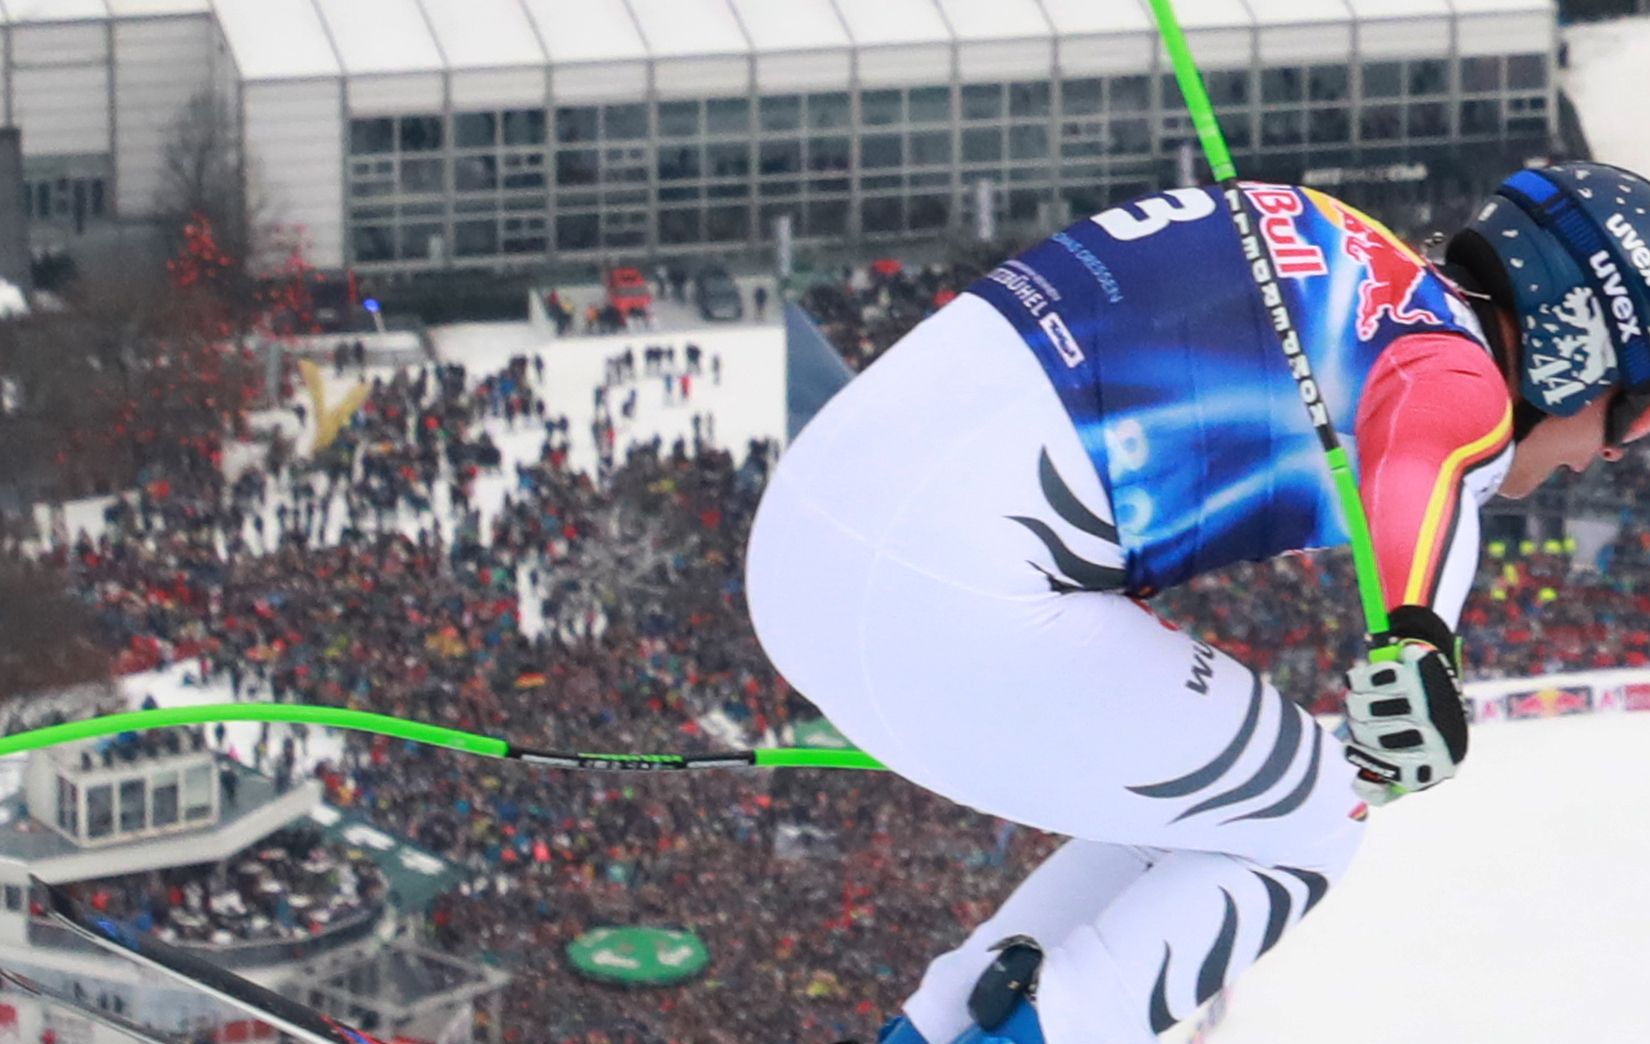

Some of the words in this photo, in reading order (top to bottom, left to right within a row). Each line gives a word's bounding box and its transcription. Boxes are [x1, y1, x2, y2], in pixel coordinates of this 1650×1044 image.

[1089, 187, 1216, 241] 3
[1243, 188, 1328, 278] Bull
[1589, 250, 1641, 343] uvex
